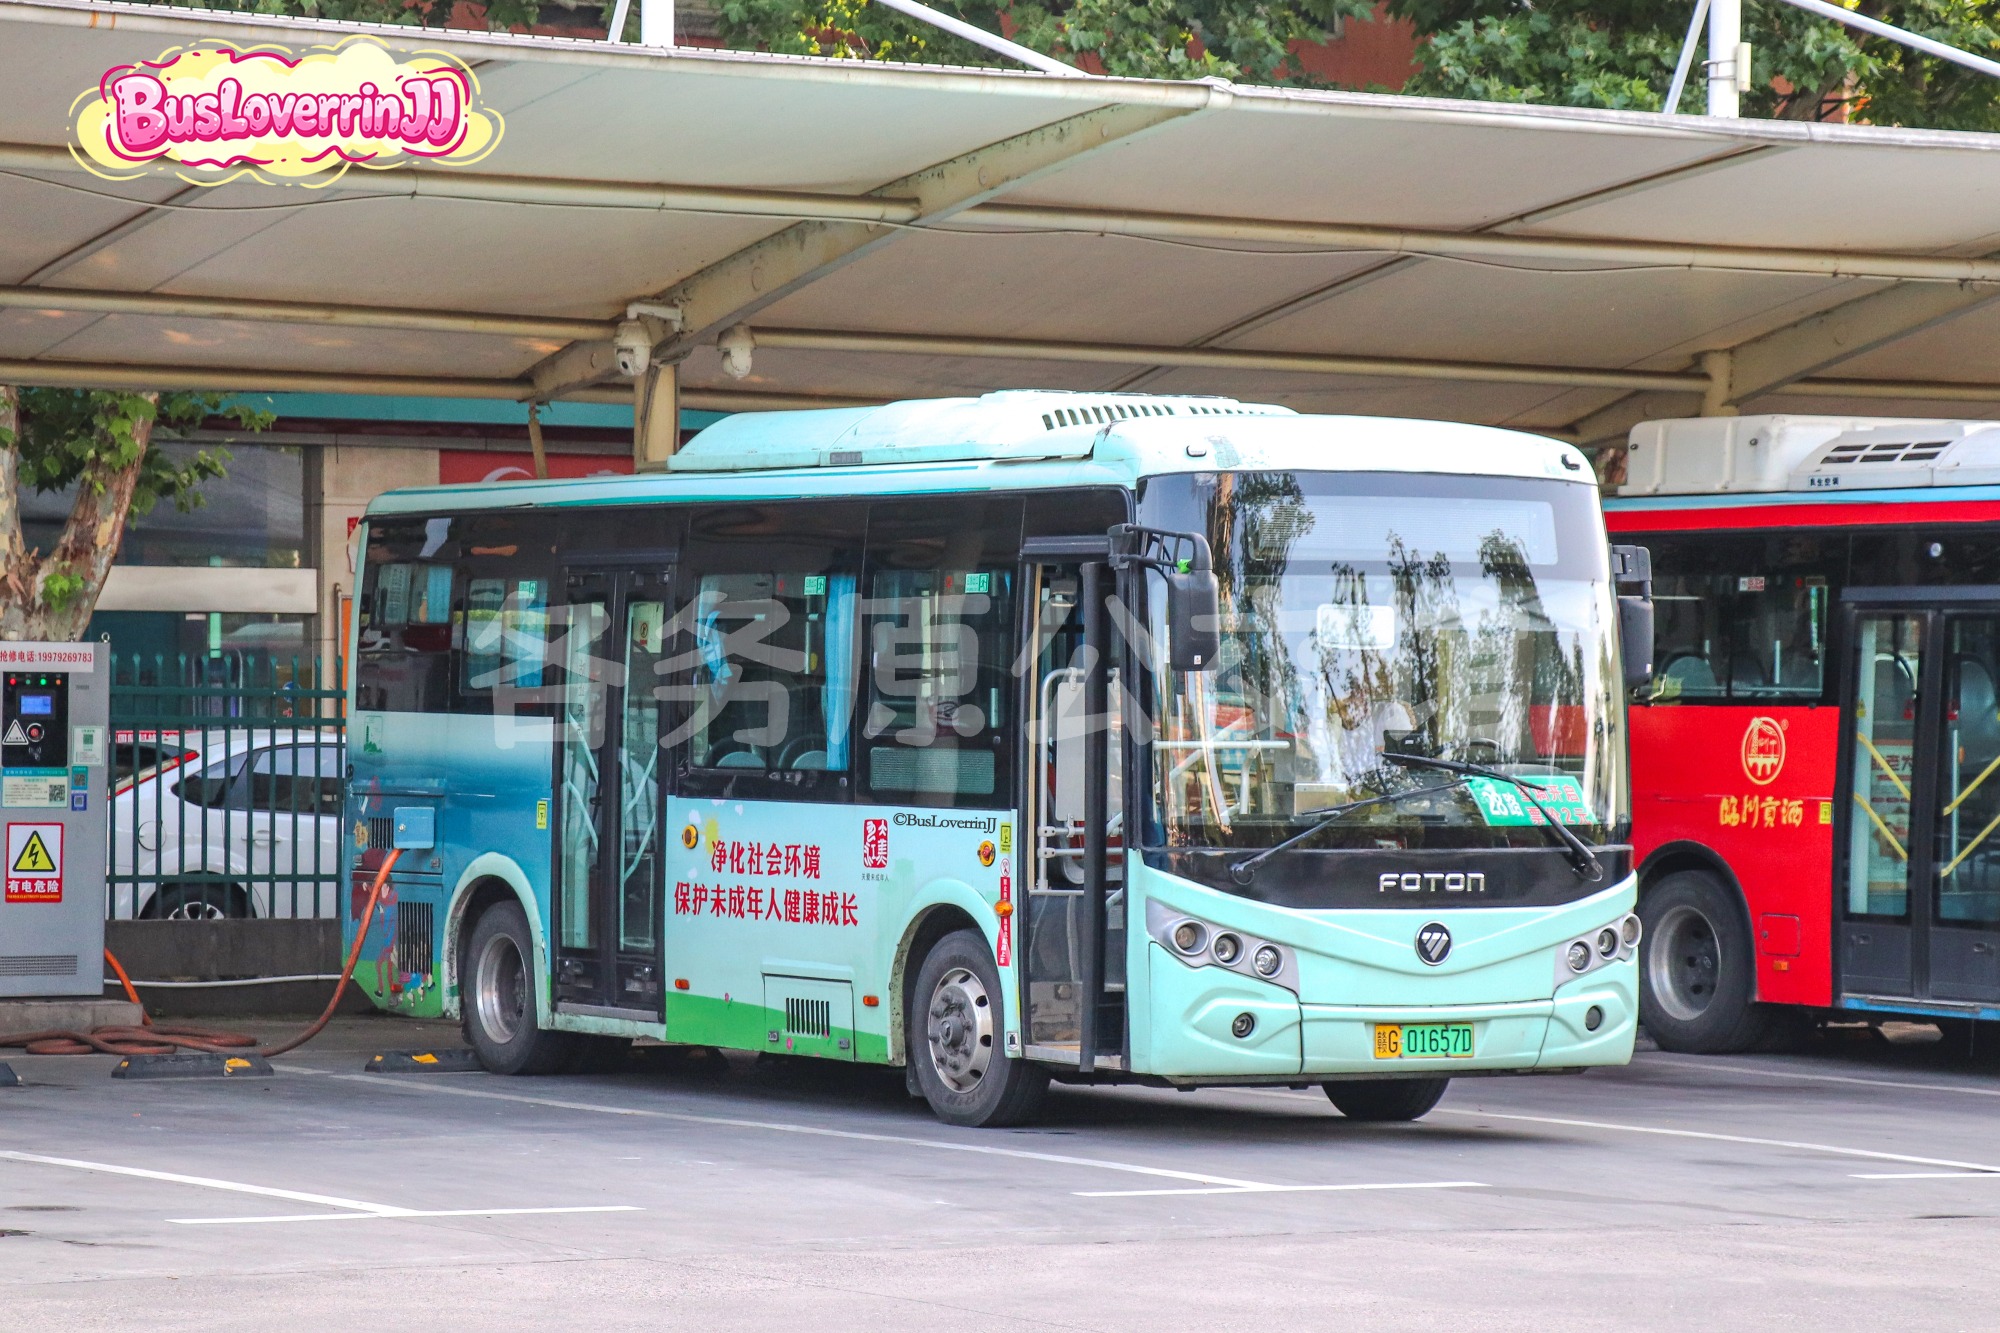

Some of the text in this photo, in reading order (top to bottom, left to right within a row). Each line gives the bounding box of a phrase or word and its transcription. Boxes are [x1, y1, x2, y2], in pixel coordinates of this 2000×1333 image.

[1482, 790, 1524, 817] 28路
[711, 840, 821, 879] 净化社会环境
[8, 880, 59, 893] 有电危险
[1379, 872, 1485, 893] FOTON
[674, 881, 858, 927] 保护未成年人健康成长
